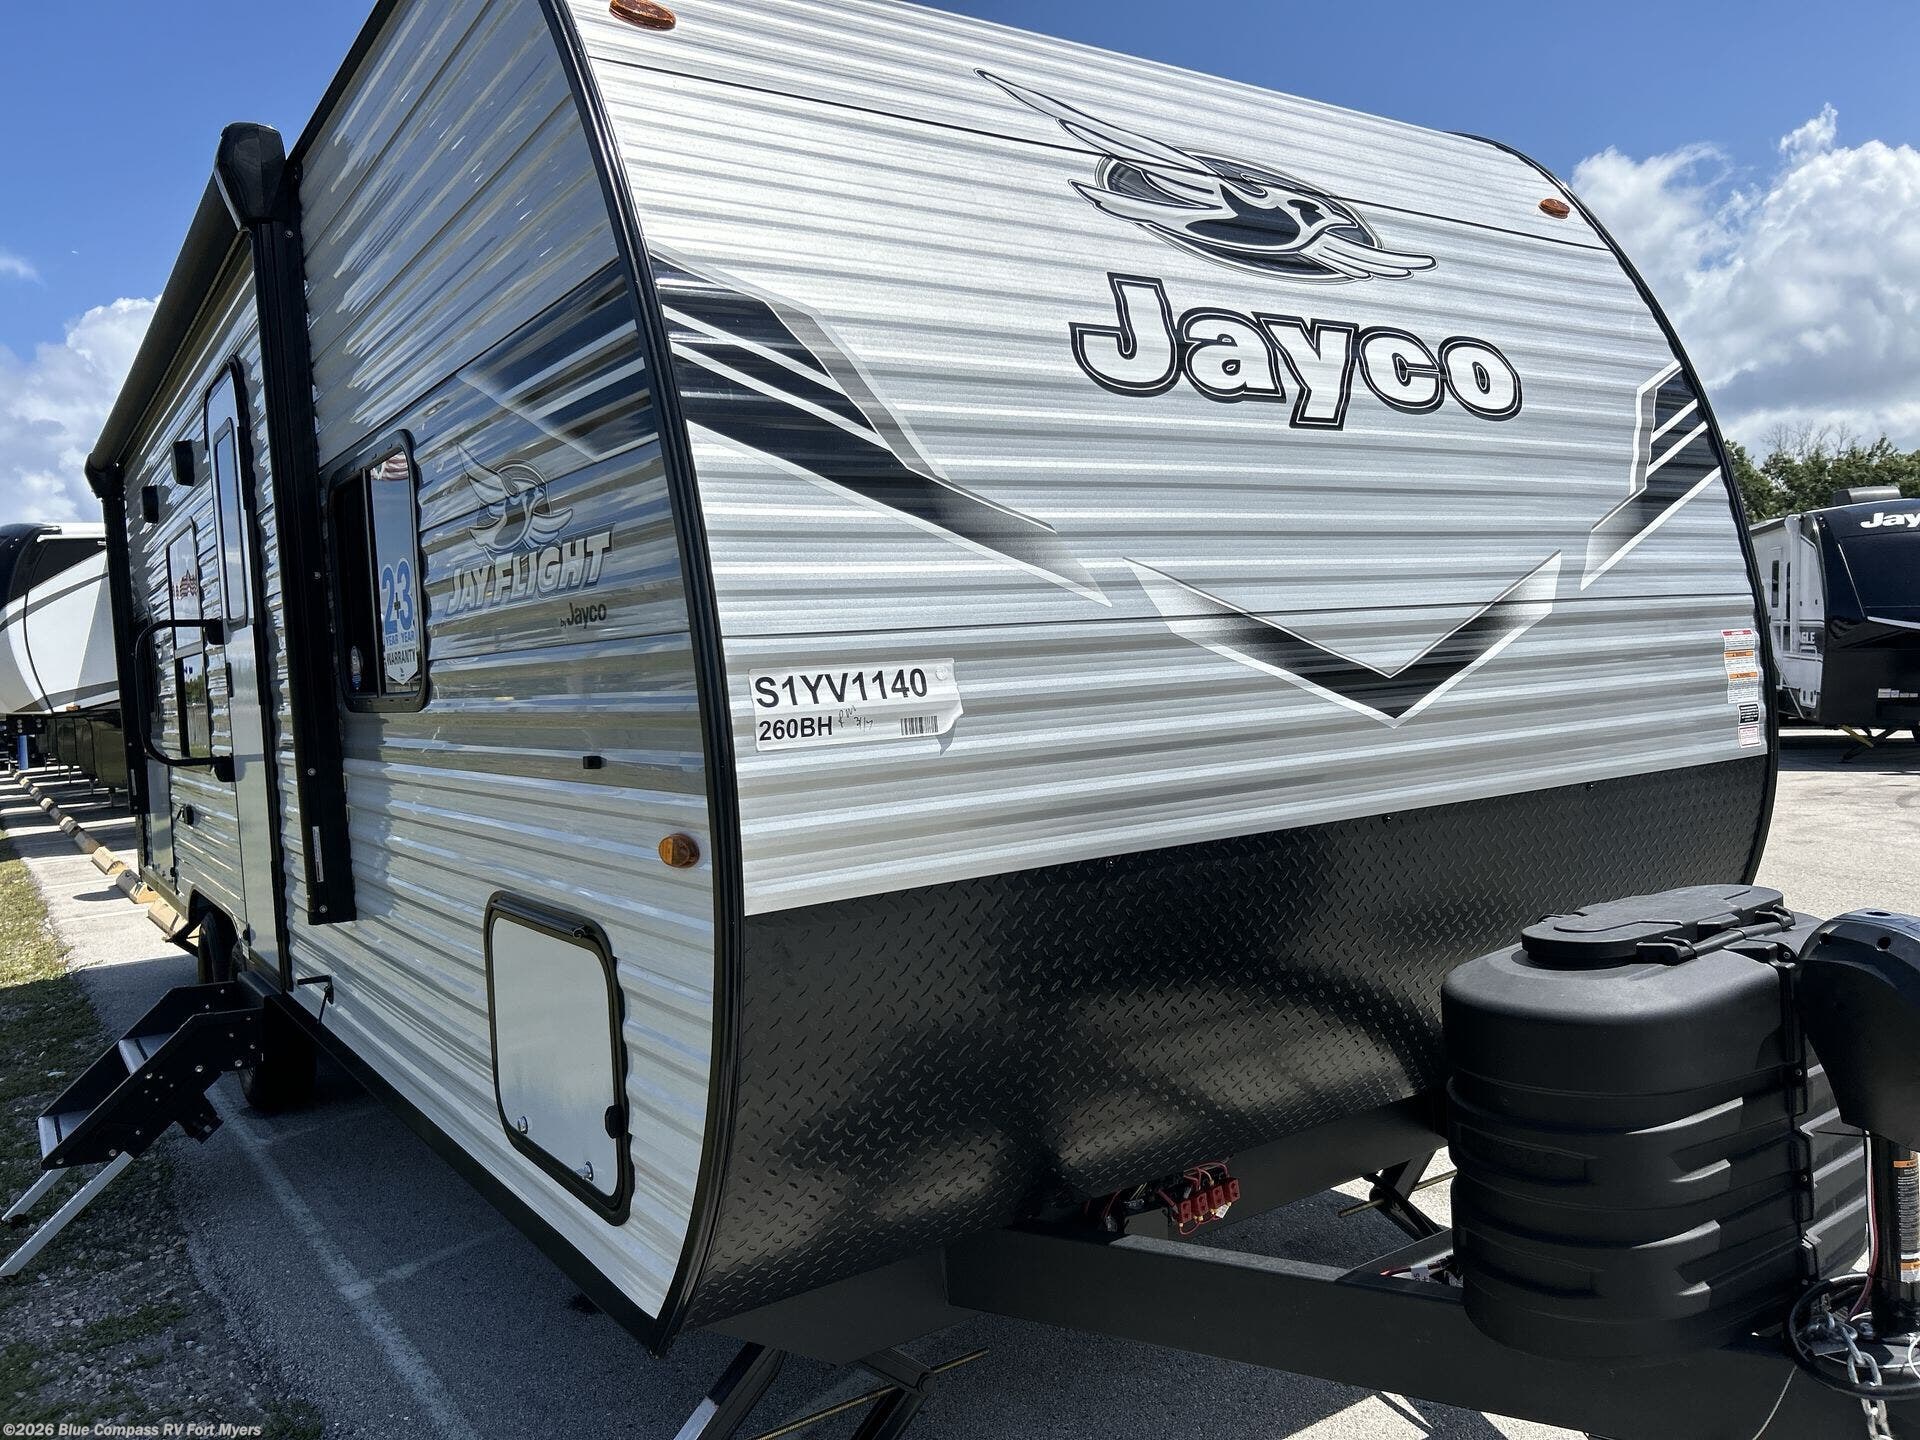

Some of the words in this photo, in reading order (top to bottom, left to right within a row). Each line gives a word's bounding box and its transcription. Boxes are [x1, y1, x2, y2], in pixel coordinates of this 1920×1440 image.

[1068, 271, 1523, 430] Jayco
[445, 564, 495, 615] JAY
[492, 531, 612, 604] FLIGHT
[566, 602, 607, 629] Jayco
[385, 634, 399, 647] YEAR
[400, 630, 415, 644] YEAR
[386, 648, 416, 666] WARRANTY
[755, 668, 928, 708] S1YV1140
[758, 715, 833, 741] 260BH
